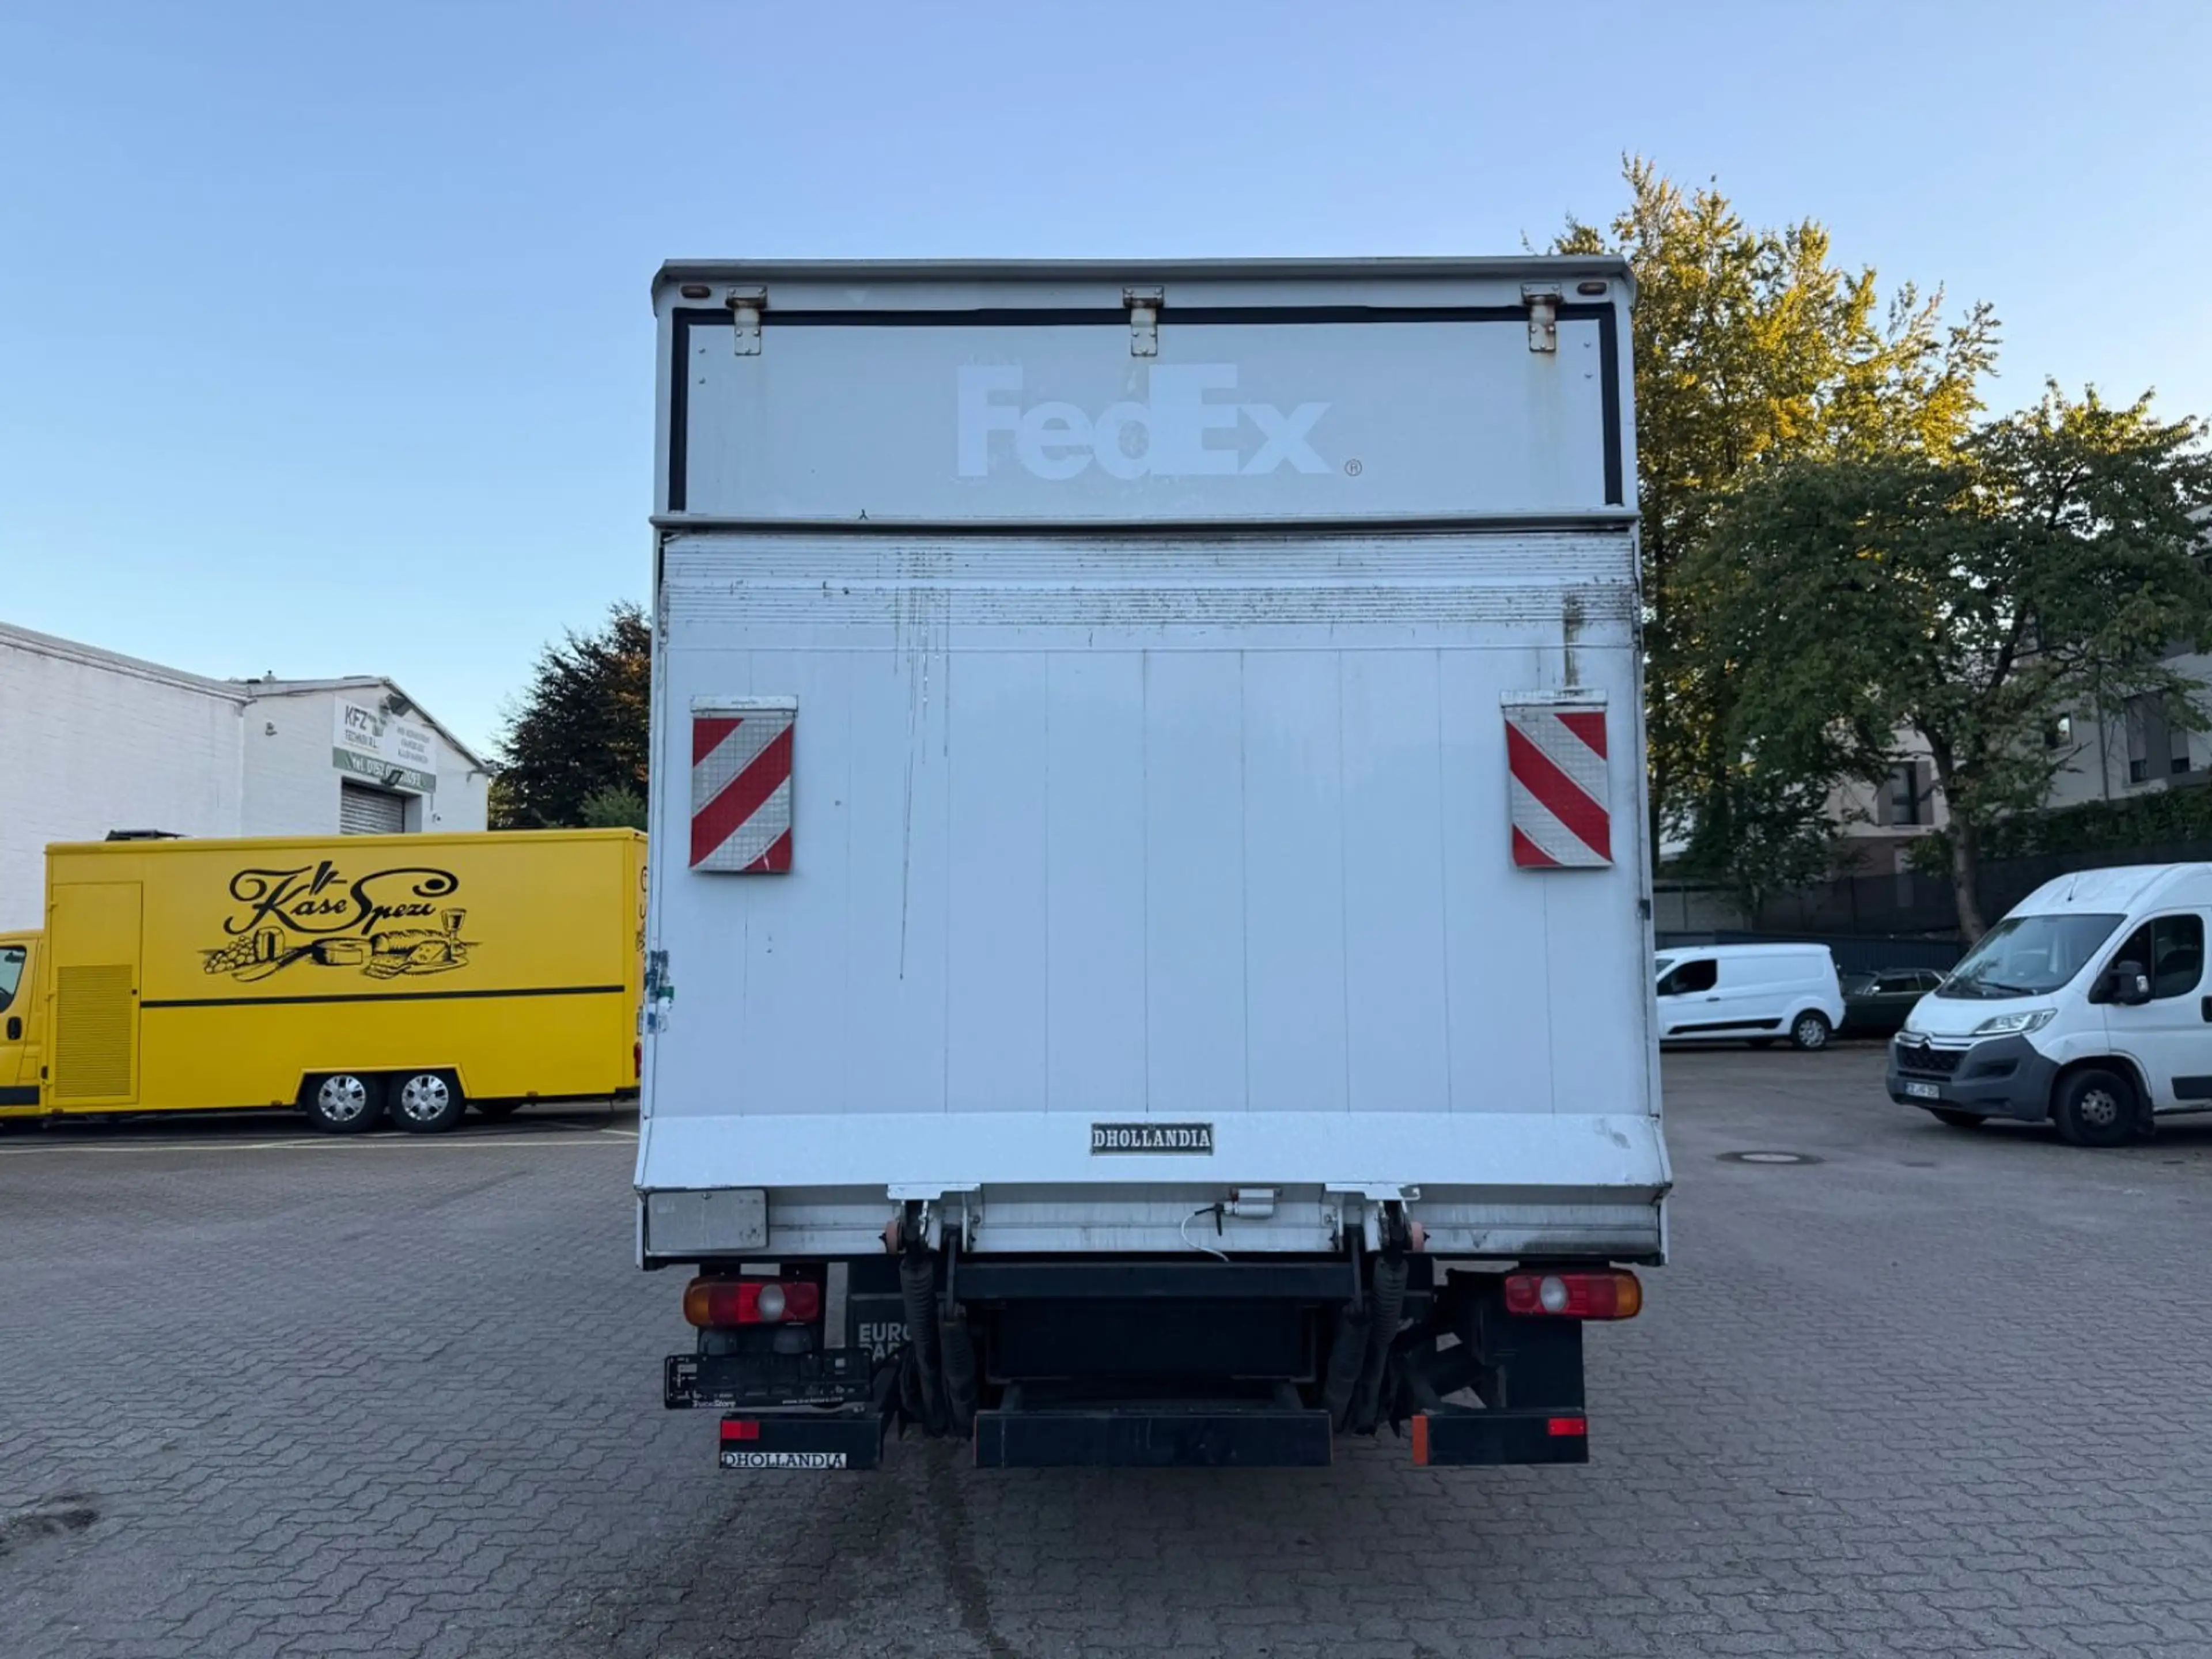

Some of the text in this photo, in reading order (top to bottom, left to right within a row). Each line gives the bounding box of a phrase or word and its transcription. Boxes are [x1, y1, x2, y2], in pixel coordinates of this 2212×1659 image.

[957, 363, 1332, 480] FedEx
[1093, 1129, 1211, 1147] DHOLLANDIA
[722, 1453, 843, 1468] DHOLLANDIA
